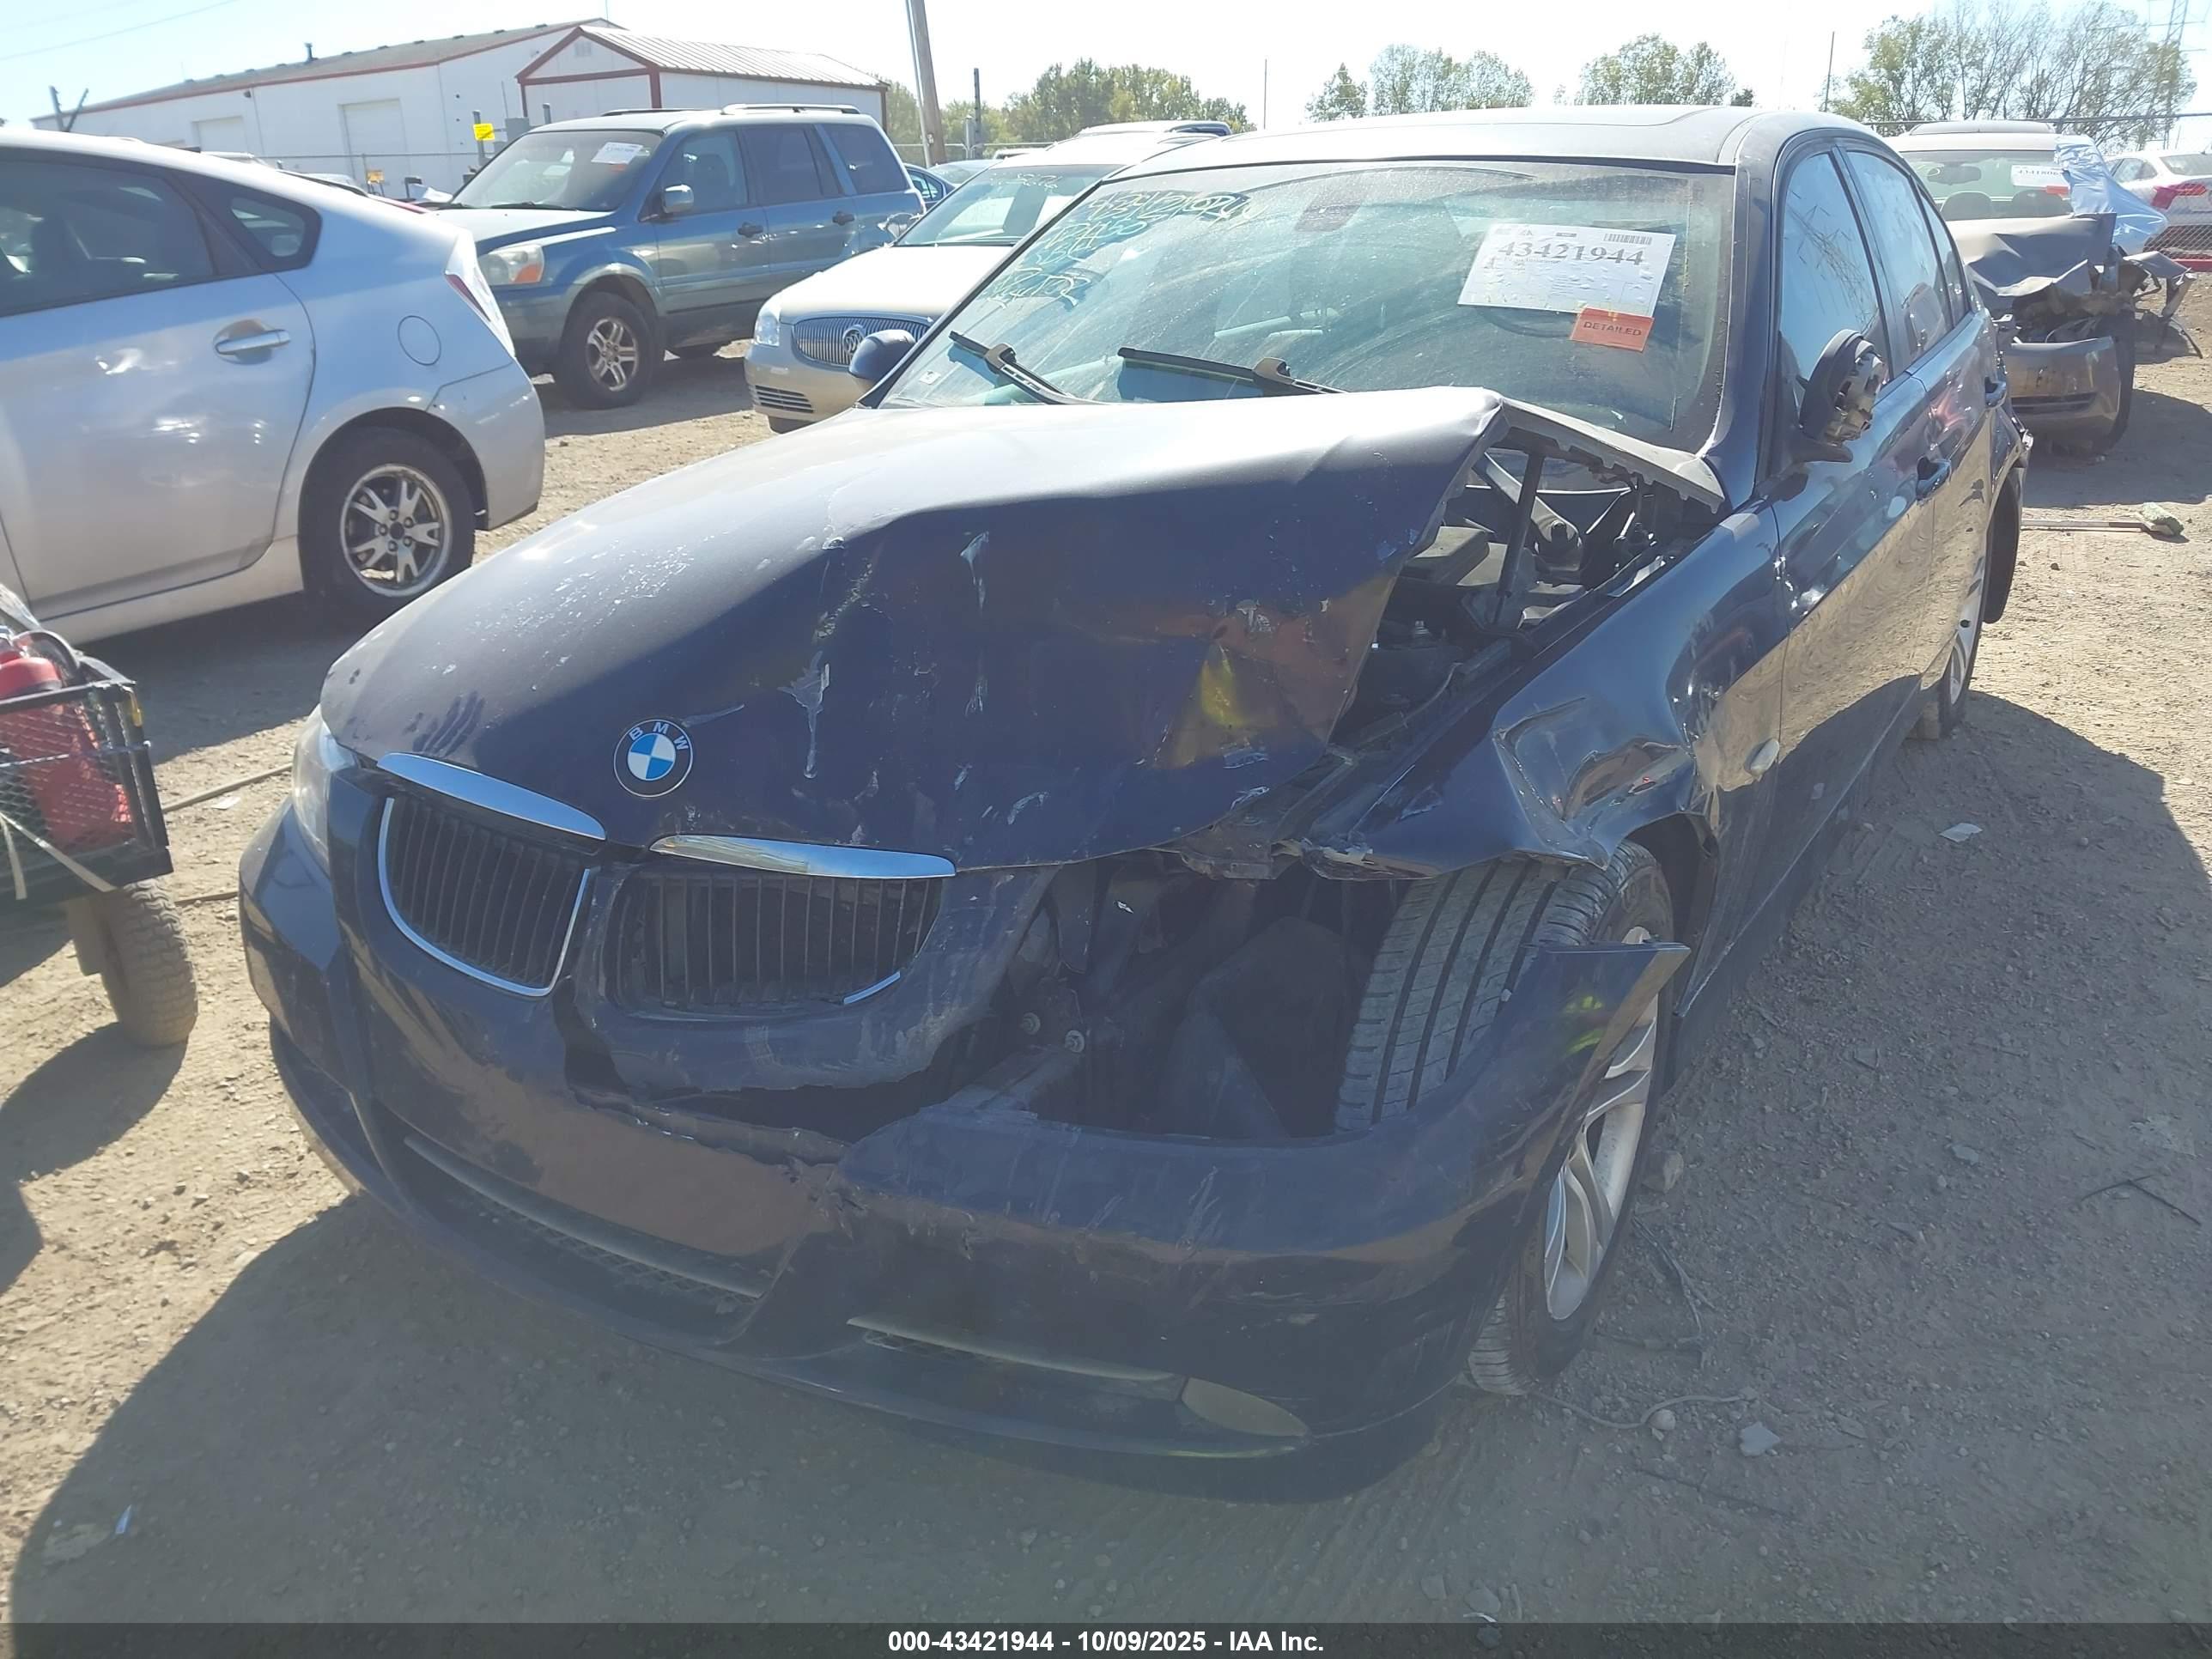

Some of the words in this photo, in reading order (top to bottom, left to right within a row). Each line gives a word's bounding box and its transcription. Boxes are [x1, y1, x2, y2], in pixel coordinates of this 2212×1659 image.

[1498, 240, 1644, 266] 43421944
[1583, 320, 1643, 337] DETAILED
[629, 721, 690, 750] BMW
